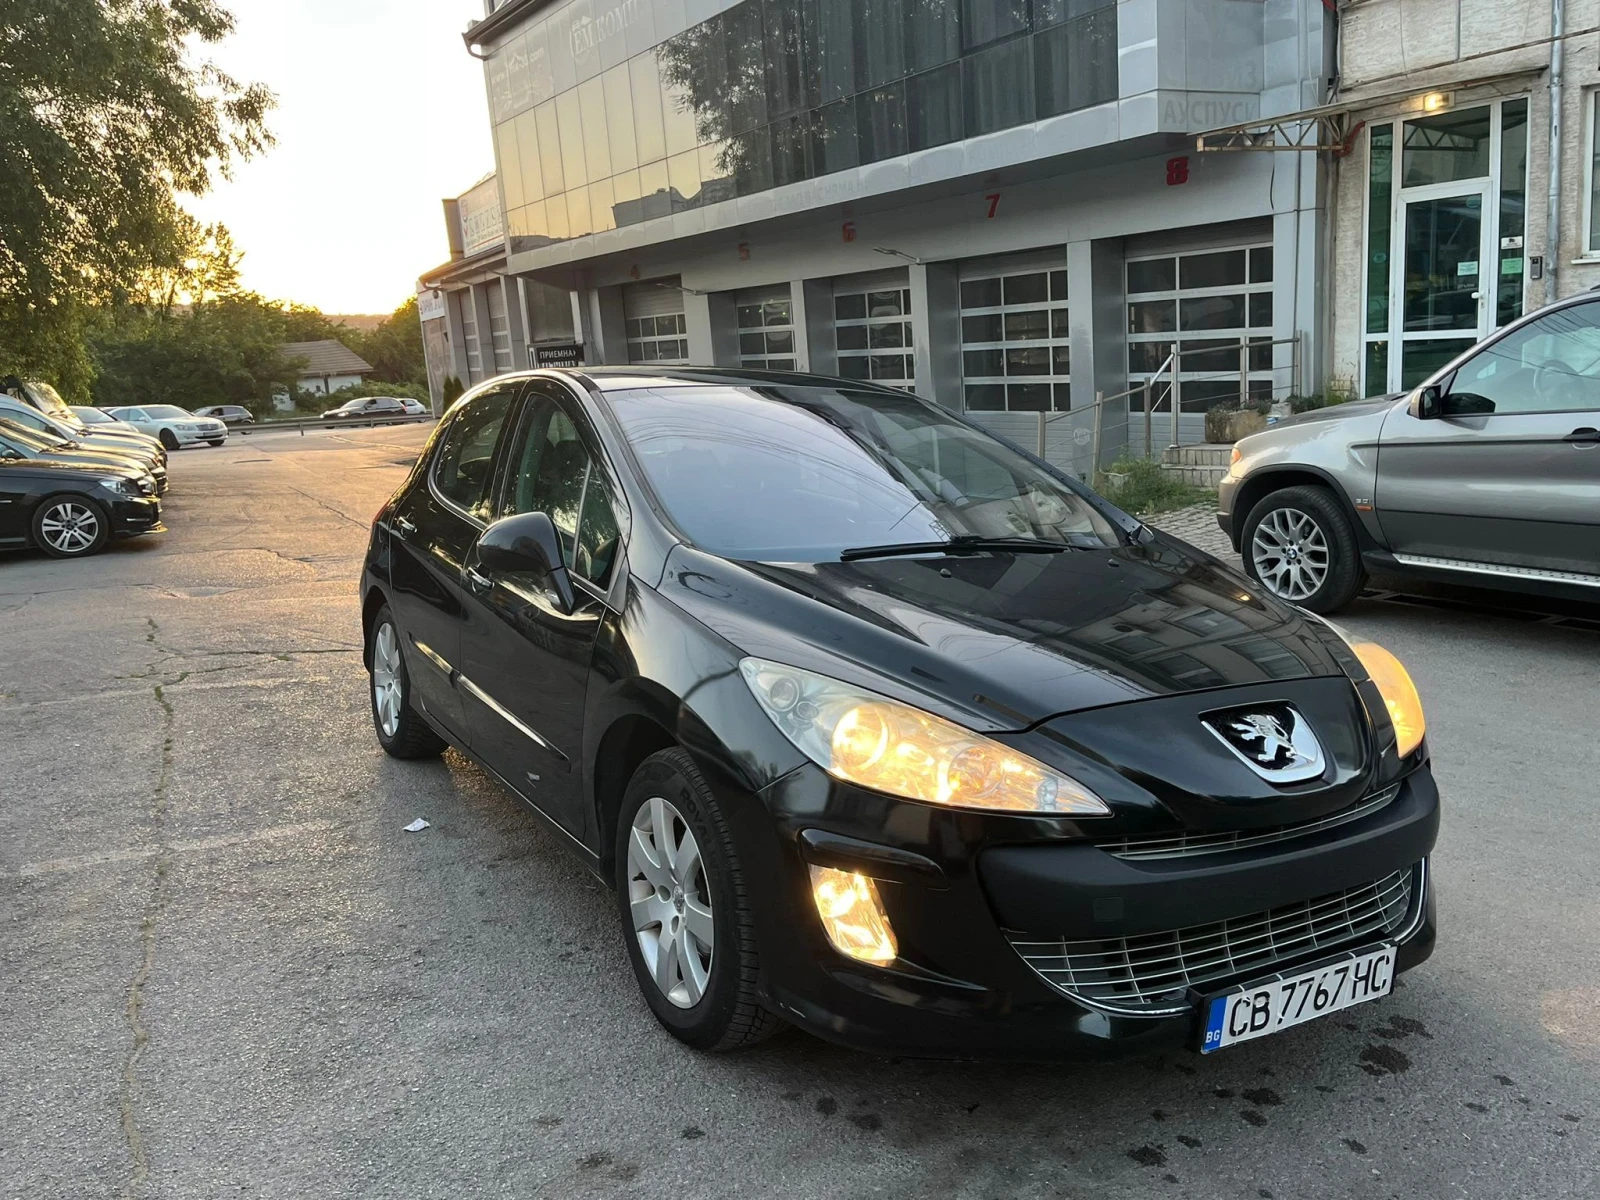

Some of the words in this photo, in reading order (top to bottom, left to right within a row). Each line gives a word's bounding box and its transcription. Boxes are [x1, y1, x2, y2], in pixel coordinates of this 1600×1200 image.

[1166, 155, 1190, 186] 8
[985, 193, 1001, 219] 7
[842, 221, 857, 243] 6
[738, 242, 751, 262] 5
[1205, 1029, 1221, 1044] BG
